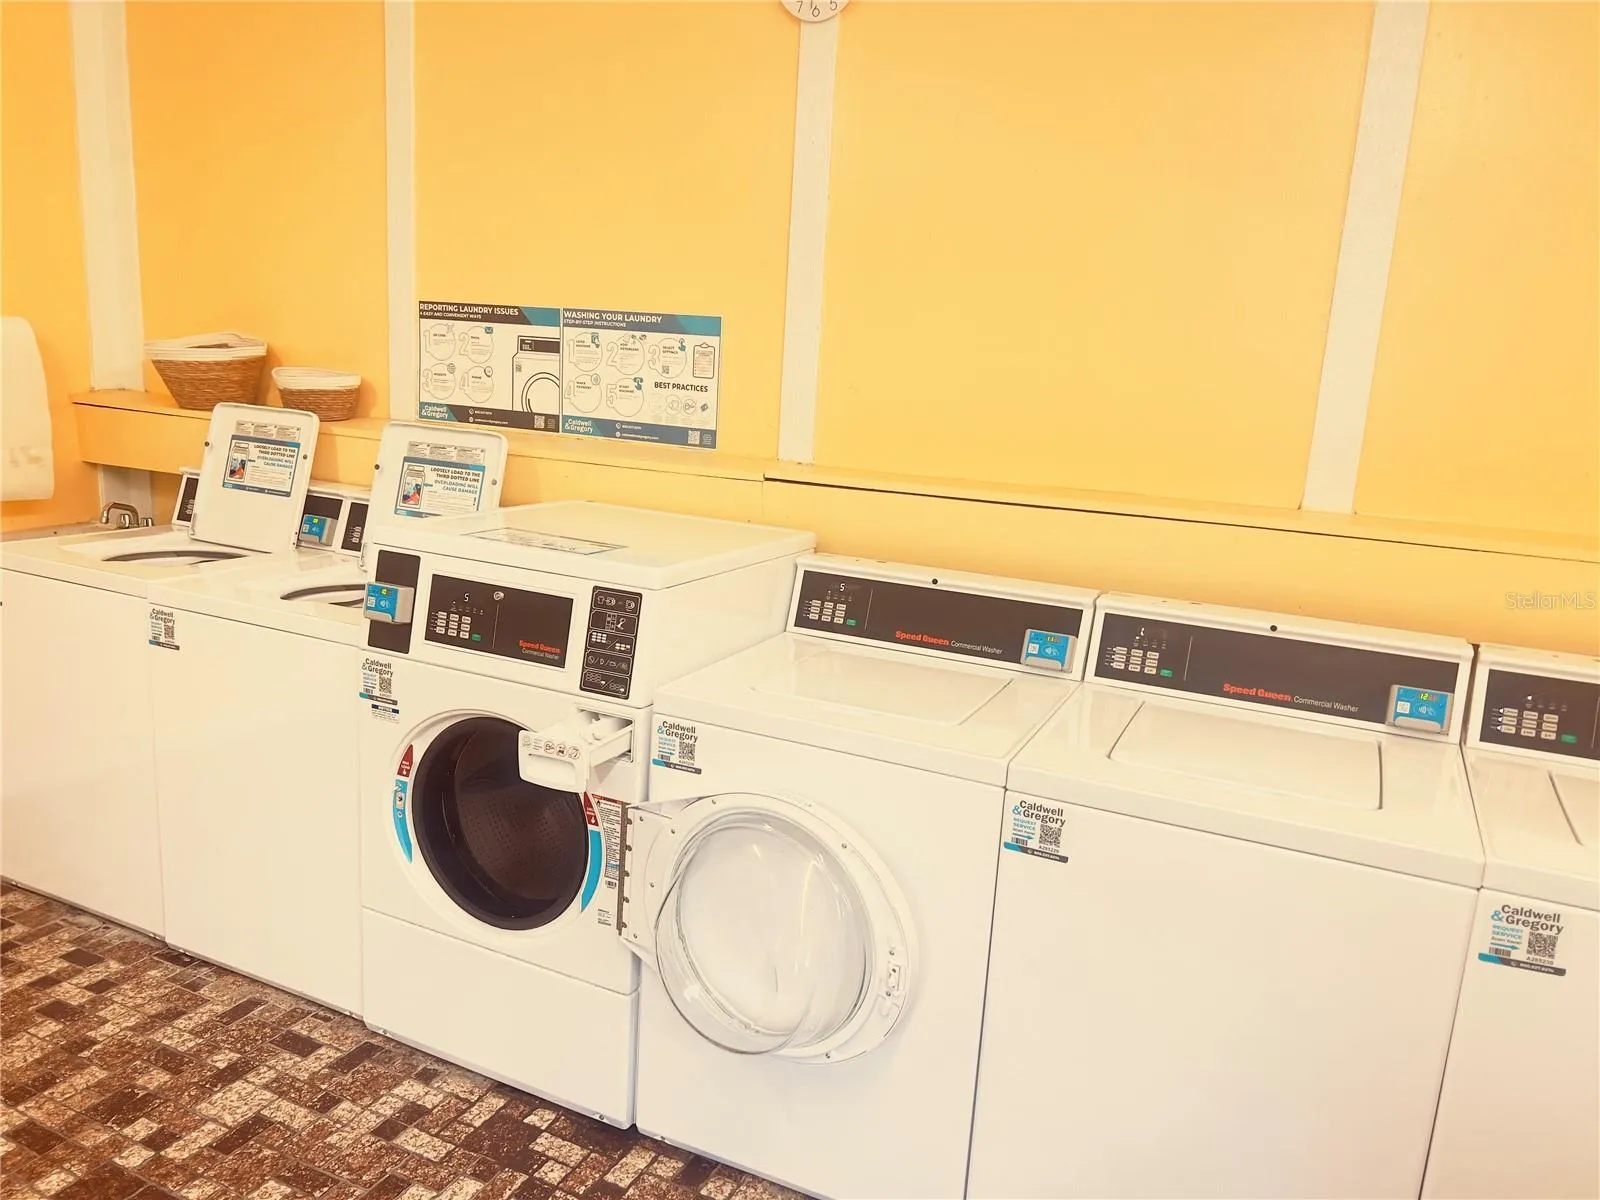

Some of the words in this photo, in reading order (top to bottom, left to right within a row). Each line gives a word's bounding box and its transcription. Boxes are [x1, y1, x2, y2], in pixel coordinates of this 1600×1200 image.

[797, 0, 804, 13] 7
[812, 5, 820, 17] 6
[420, 303, 458, 313] REPORTING
[460, 306, 493, 315] LAUNDRY
[494, 307, 519, 316] ISSUES
[563, 311, 600, 320] WASHING
[602, 312, 623, 321] YOUR
[625, 314, 662, 323] LAUNDRY
[654, 381, 671, 389] BEST
[672, 383, 708, 393] PRACTICES
[423, 404, 446, 413] Caldwell
[567, 419, 592, 427] Caldwell
[895, 631, 921, 642] Speed
[922, 634, 949, 646] Queen
[950, 640, 982, 651] Commercial
[982, 644, 1003, 654] Washer
[366, 657, 392, 669] Caldwell
[1223, 683, 1256, 695] Speed
[1257, 687, 1291, 701] Queen
[1293, 695, 1332, 708] Commercial
[1333, 701, 1359, 713] Washer
[662, 720, 696, 734] Caldwell
[1020, 800, 1063, 818] Caldwell
[1501, 904, 1560, 924] Caldwell
